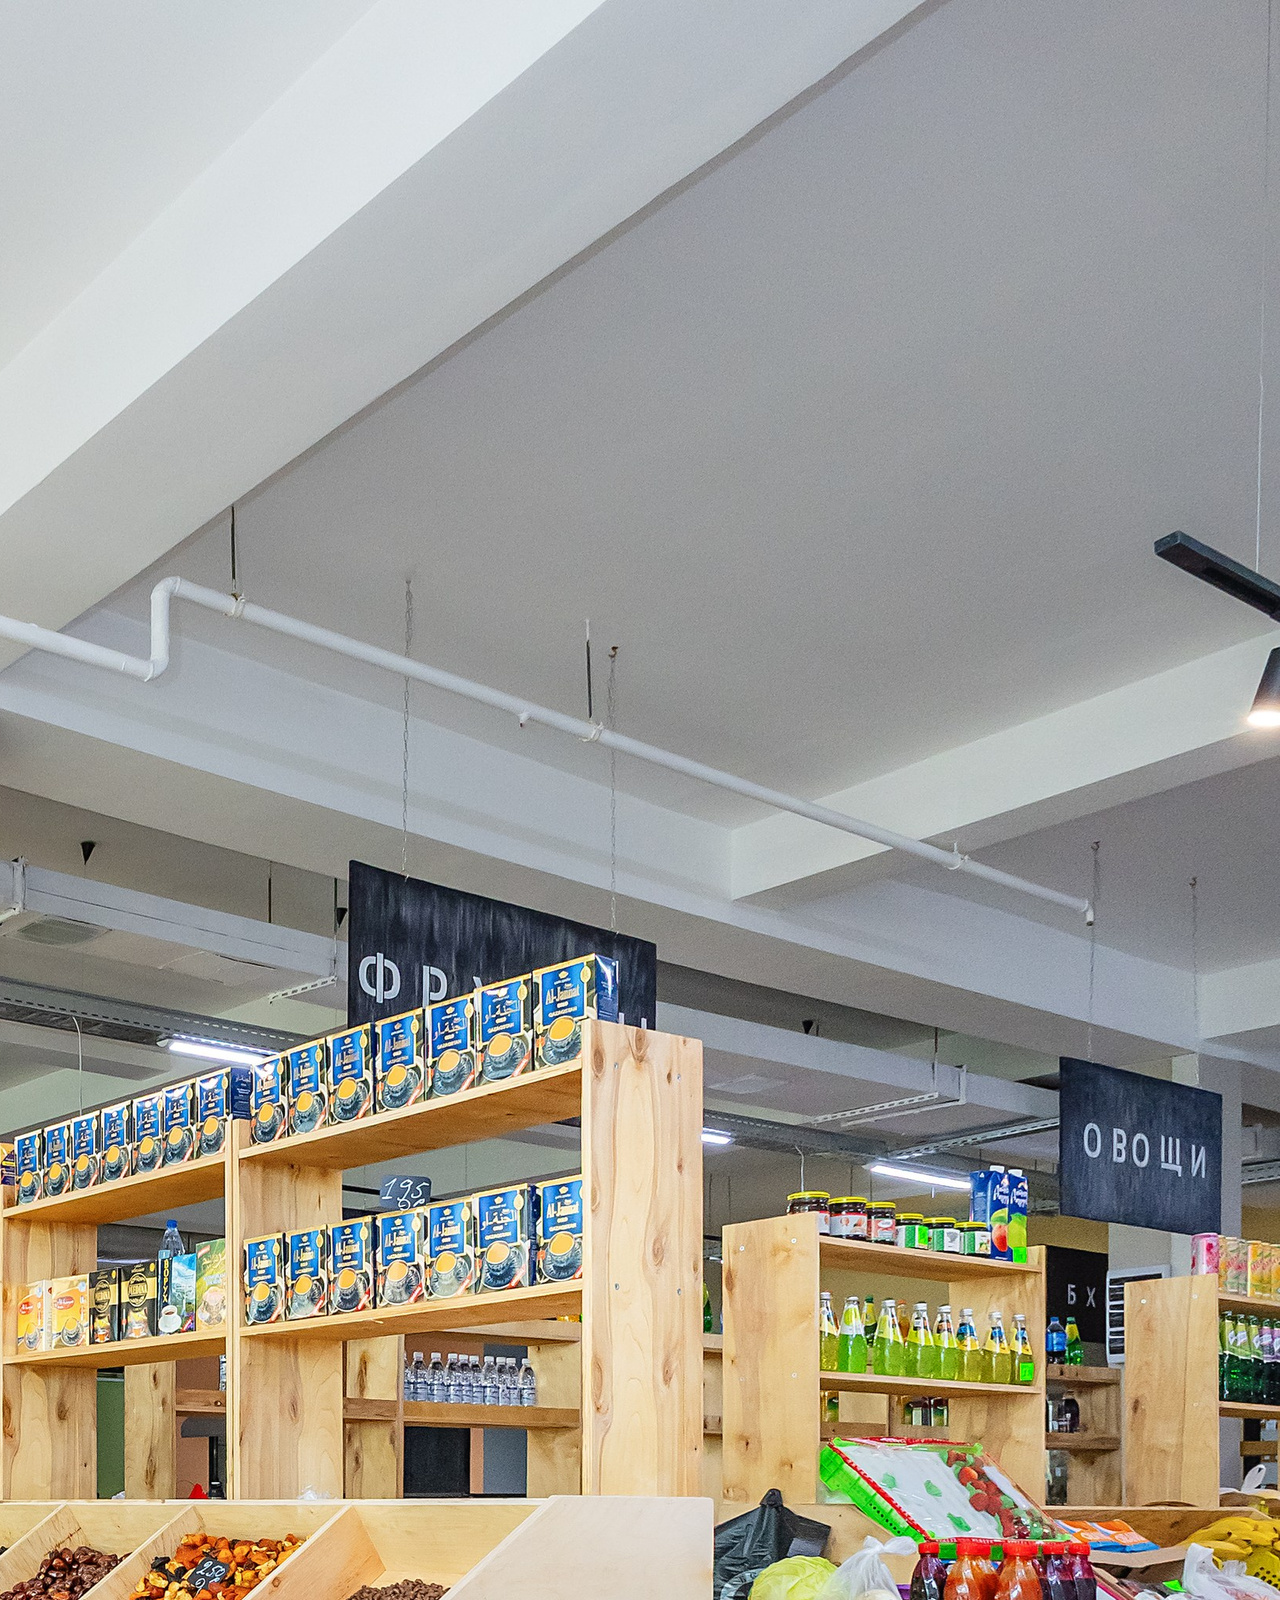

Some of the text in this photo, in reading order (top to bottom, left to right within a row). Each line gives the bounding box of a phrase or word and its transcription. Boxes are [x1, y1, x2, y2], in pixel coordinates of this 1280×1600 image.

[1083, 1122, 1206, 1179] ОВОЩИ
[382, 1178, 430, 1201] 195
[195, 1560, 226, 1577] 250
